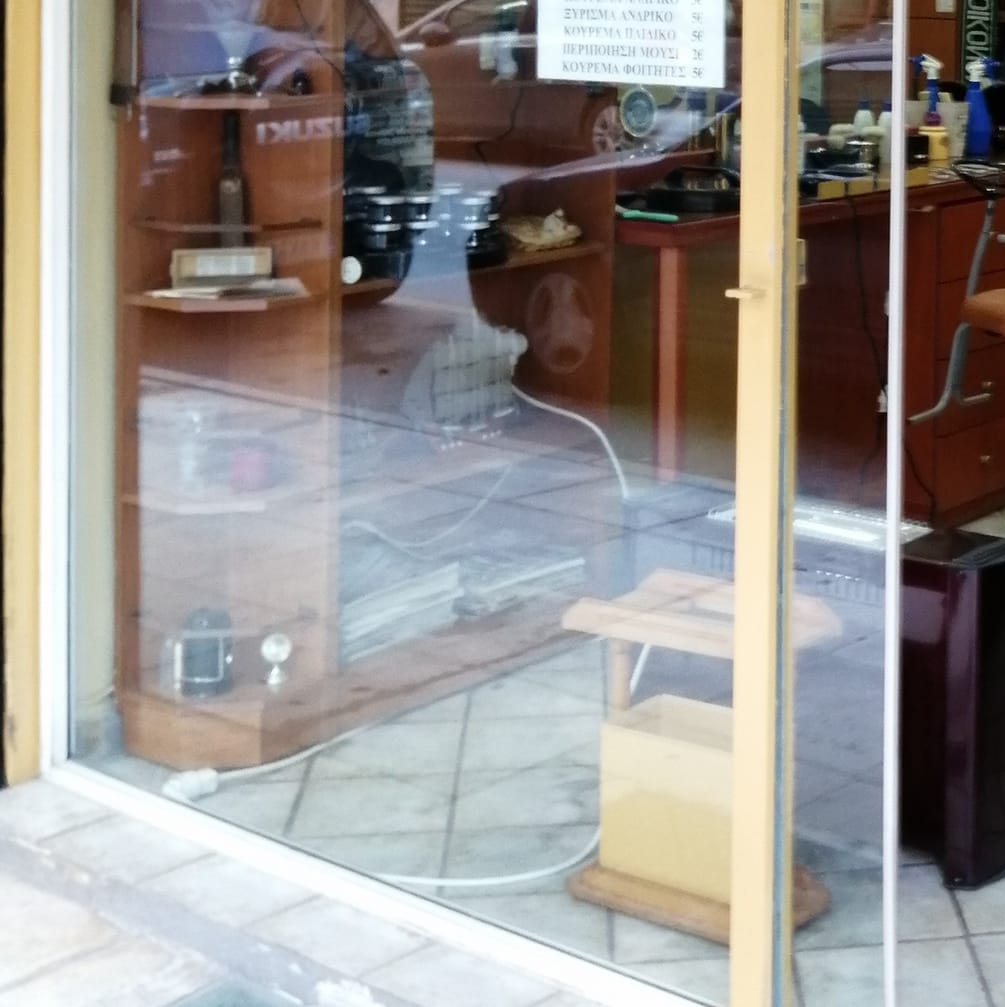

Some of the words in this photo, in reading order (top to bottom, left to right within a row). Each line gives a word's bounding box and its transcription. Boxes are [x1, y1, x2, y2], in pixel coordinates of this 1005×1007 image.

[563, 8, 616, 21] ΞΥΡΙΣΜΑ
[621, 9, 673, 23] ΑΝΔΡΙΚΟ
[563, 25, 621, 39] ΚΟΥΡΕΜΑ
[562, 60, 620, 74] ΚΟΥΡΕΜΑ
[623, 64, 687, 79] ΦΟΙΤΗΤΕΣ
